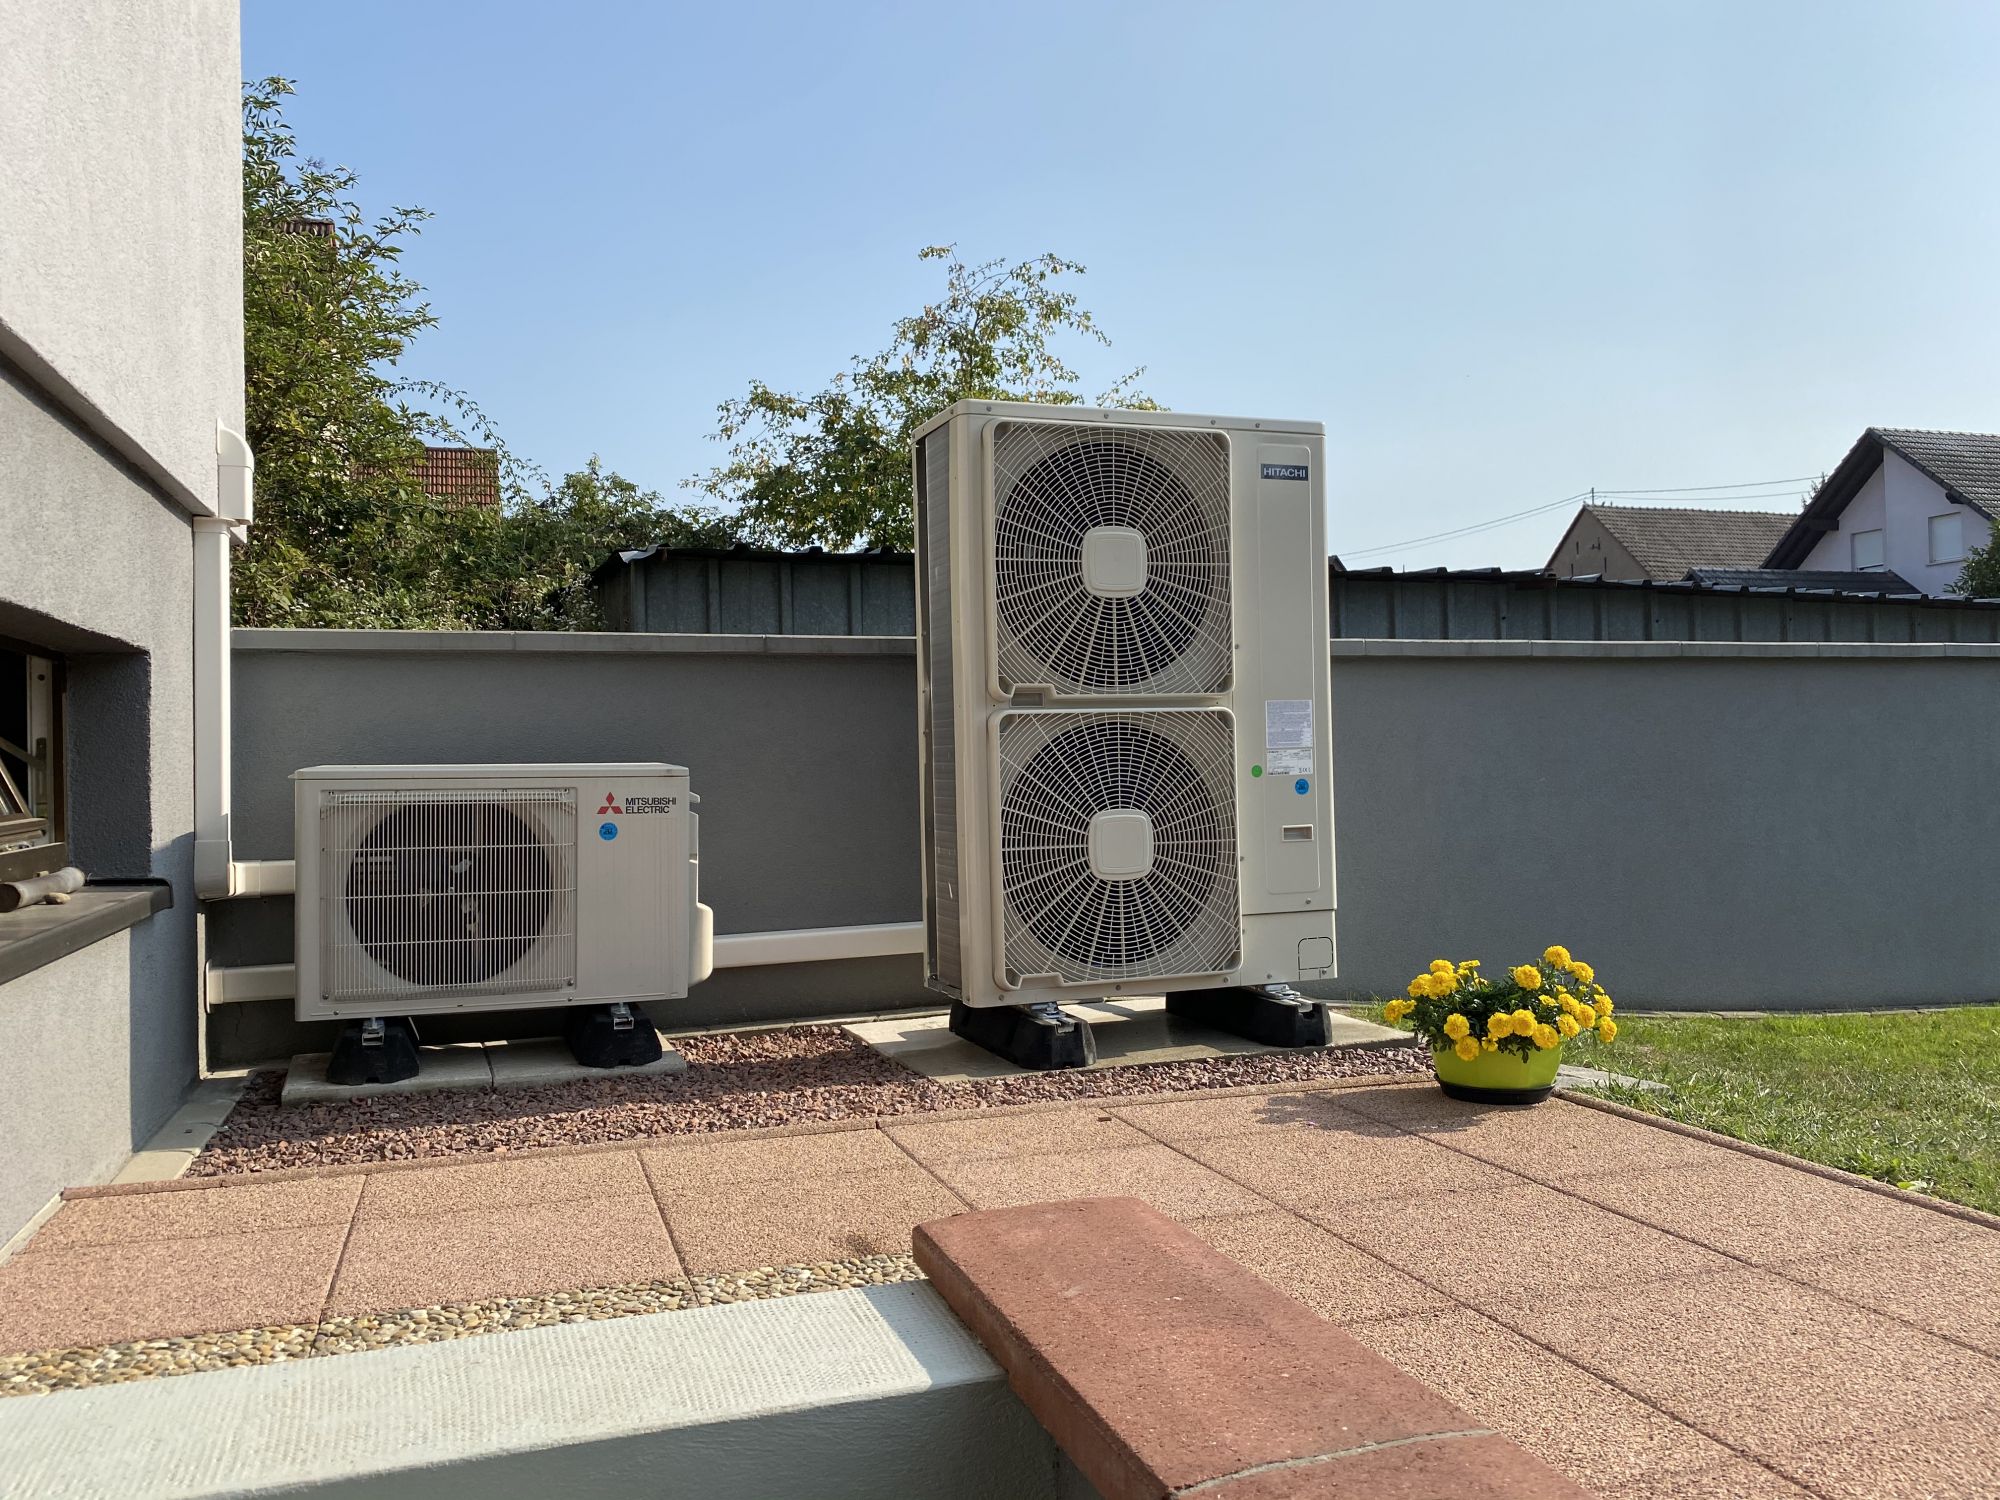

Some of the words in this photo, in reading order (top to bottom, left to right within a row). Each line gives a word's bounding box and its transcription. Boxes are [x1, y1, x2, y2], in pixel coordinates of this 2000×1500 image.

[1263, 467, 1306, 478] HITACHI
[625, 797, 677, 806] MITSUBISHI
[625, 805, 670, 814] ELECTRIC
